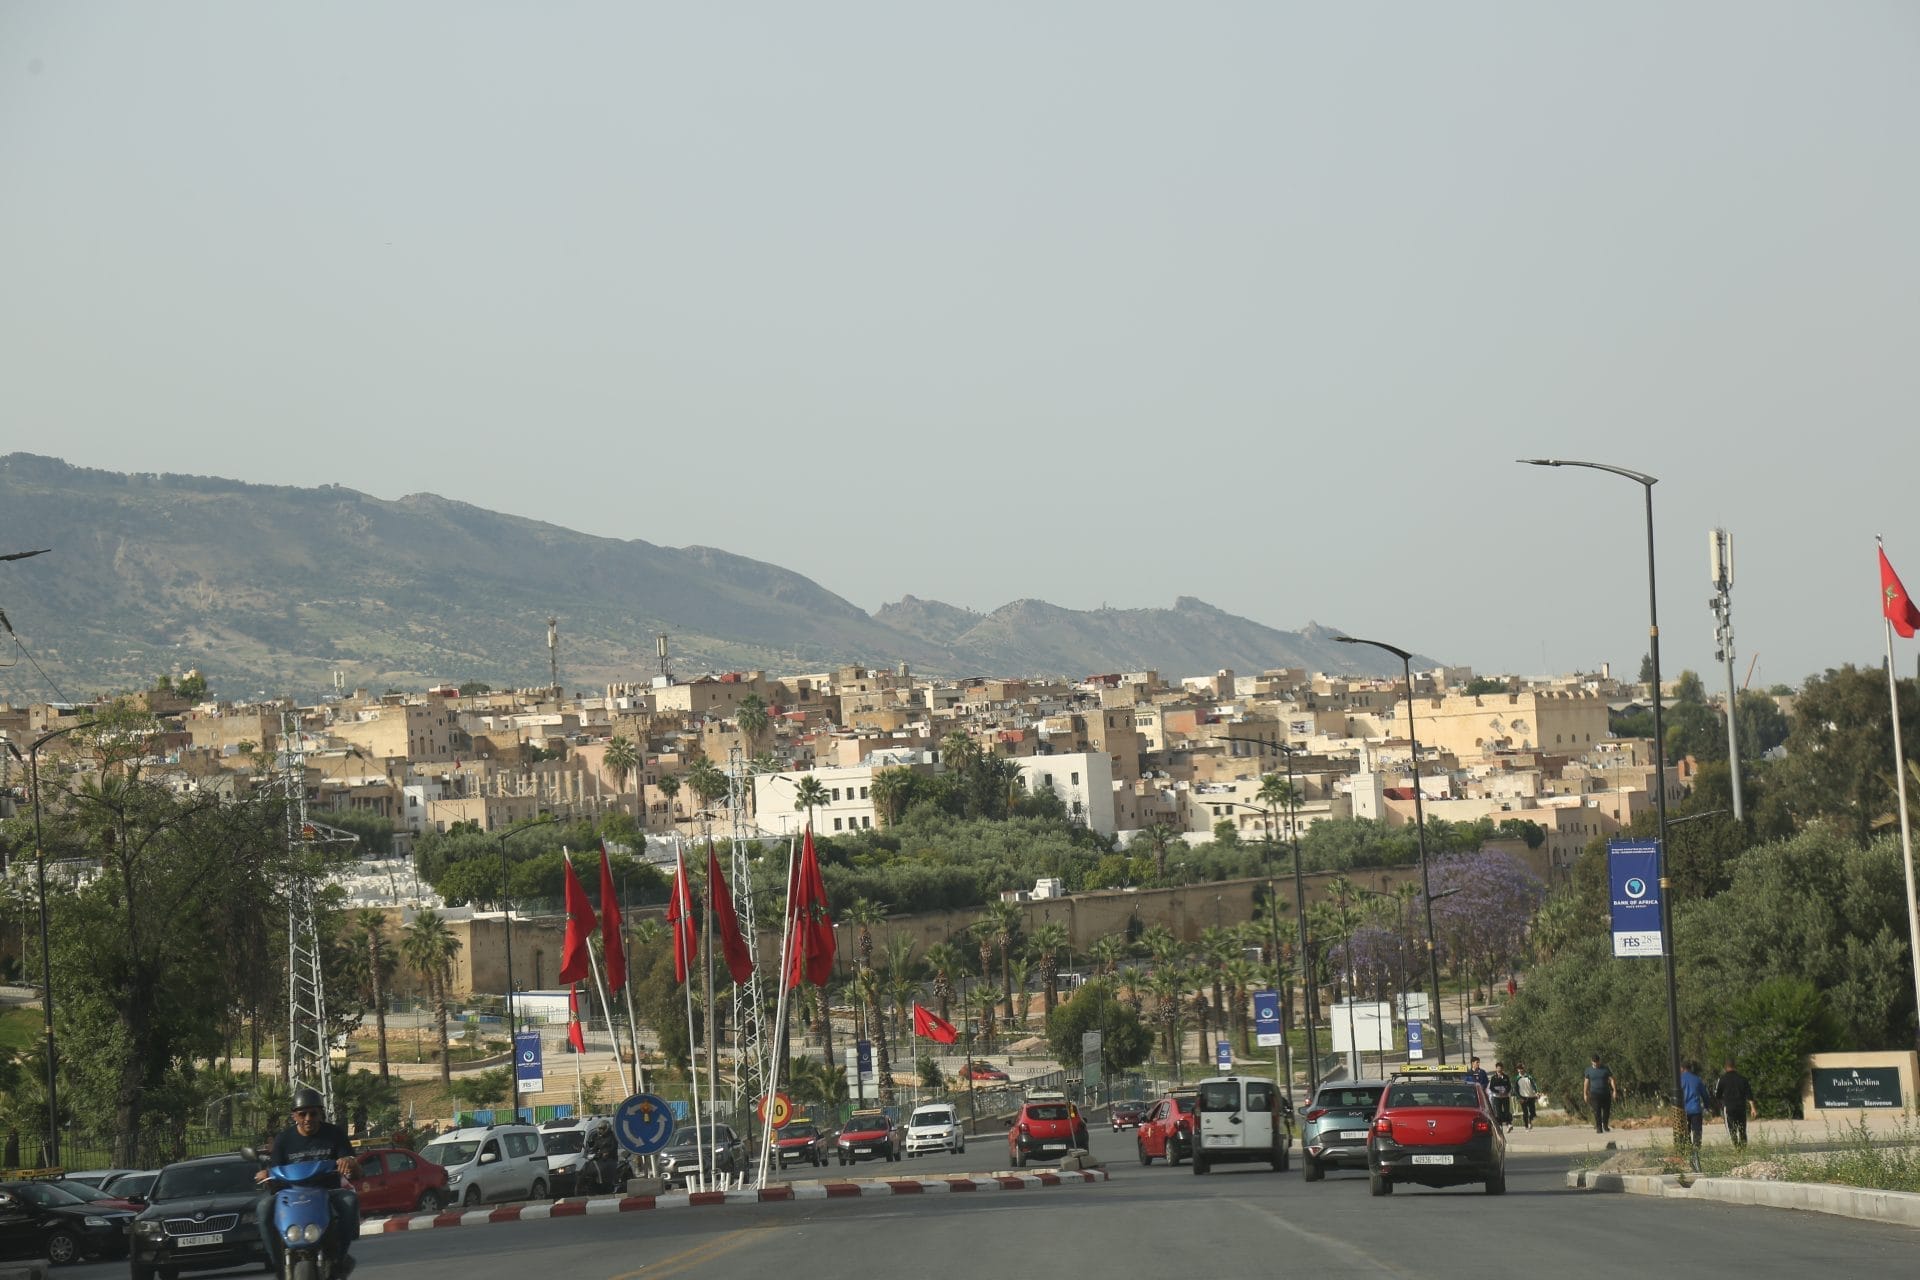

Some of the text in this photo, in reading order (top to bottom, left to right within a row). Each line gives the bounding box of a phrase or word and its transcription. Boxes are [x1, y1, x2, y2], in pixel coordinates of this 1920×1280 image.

[1624, 936, 1640, 947] FÈS
[1832, 1078, 1880, 1087] Palais Medina
